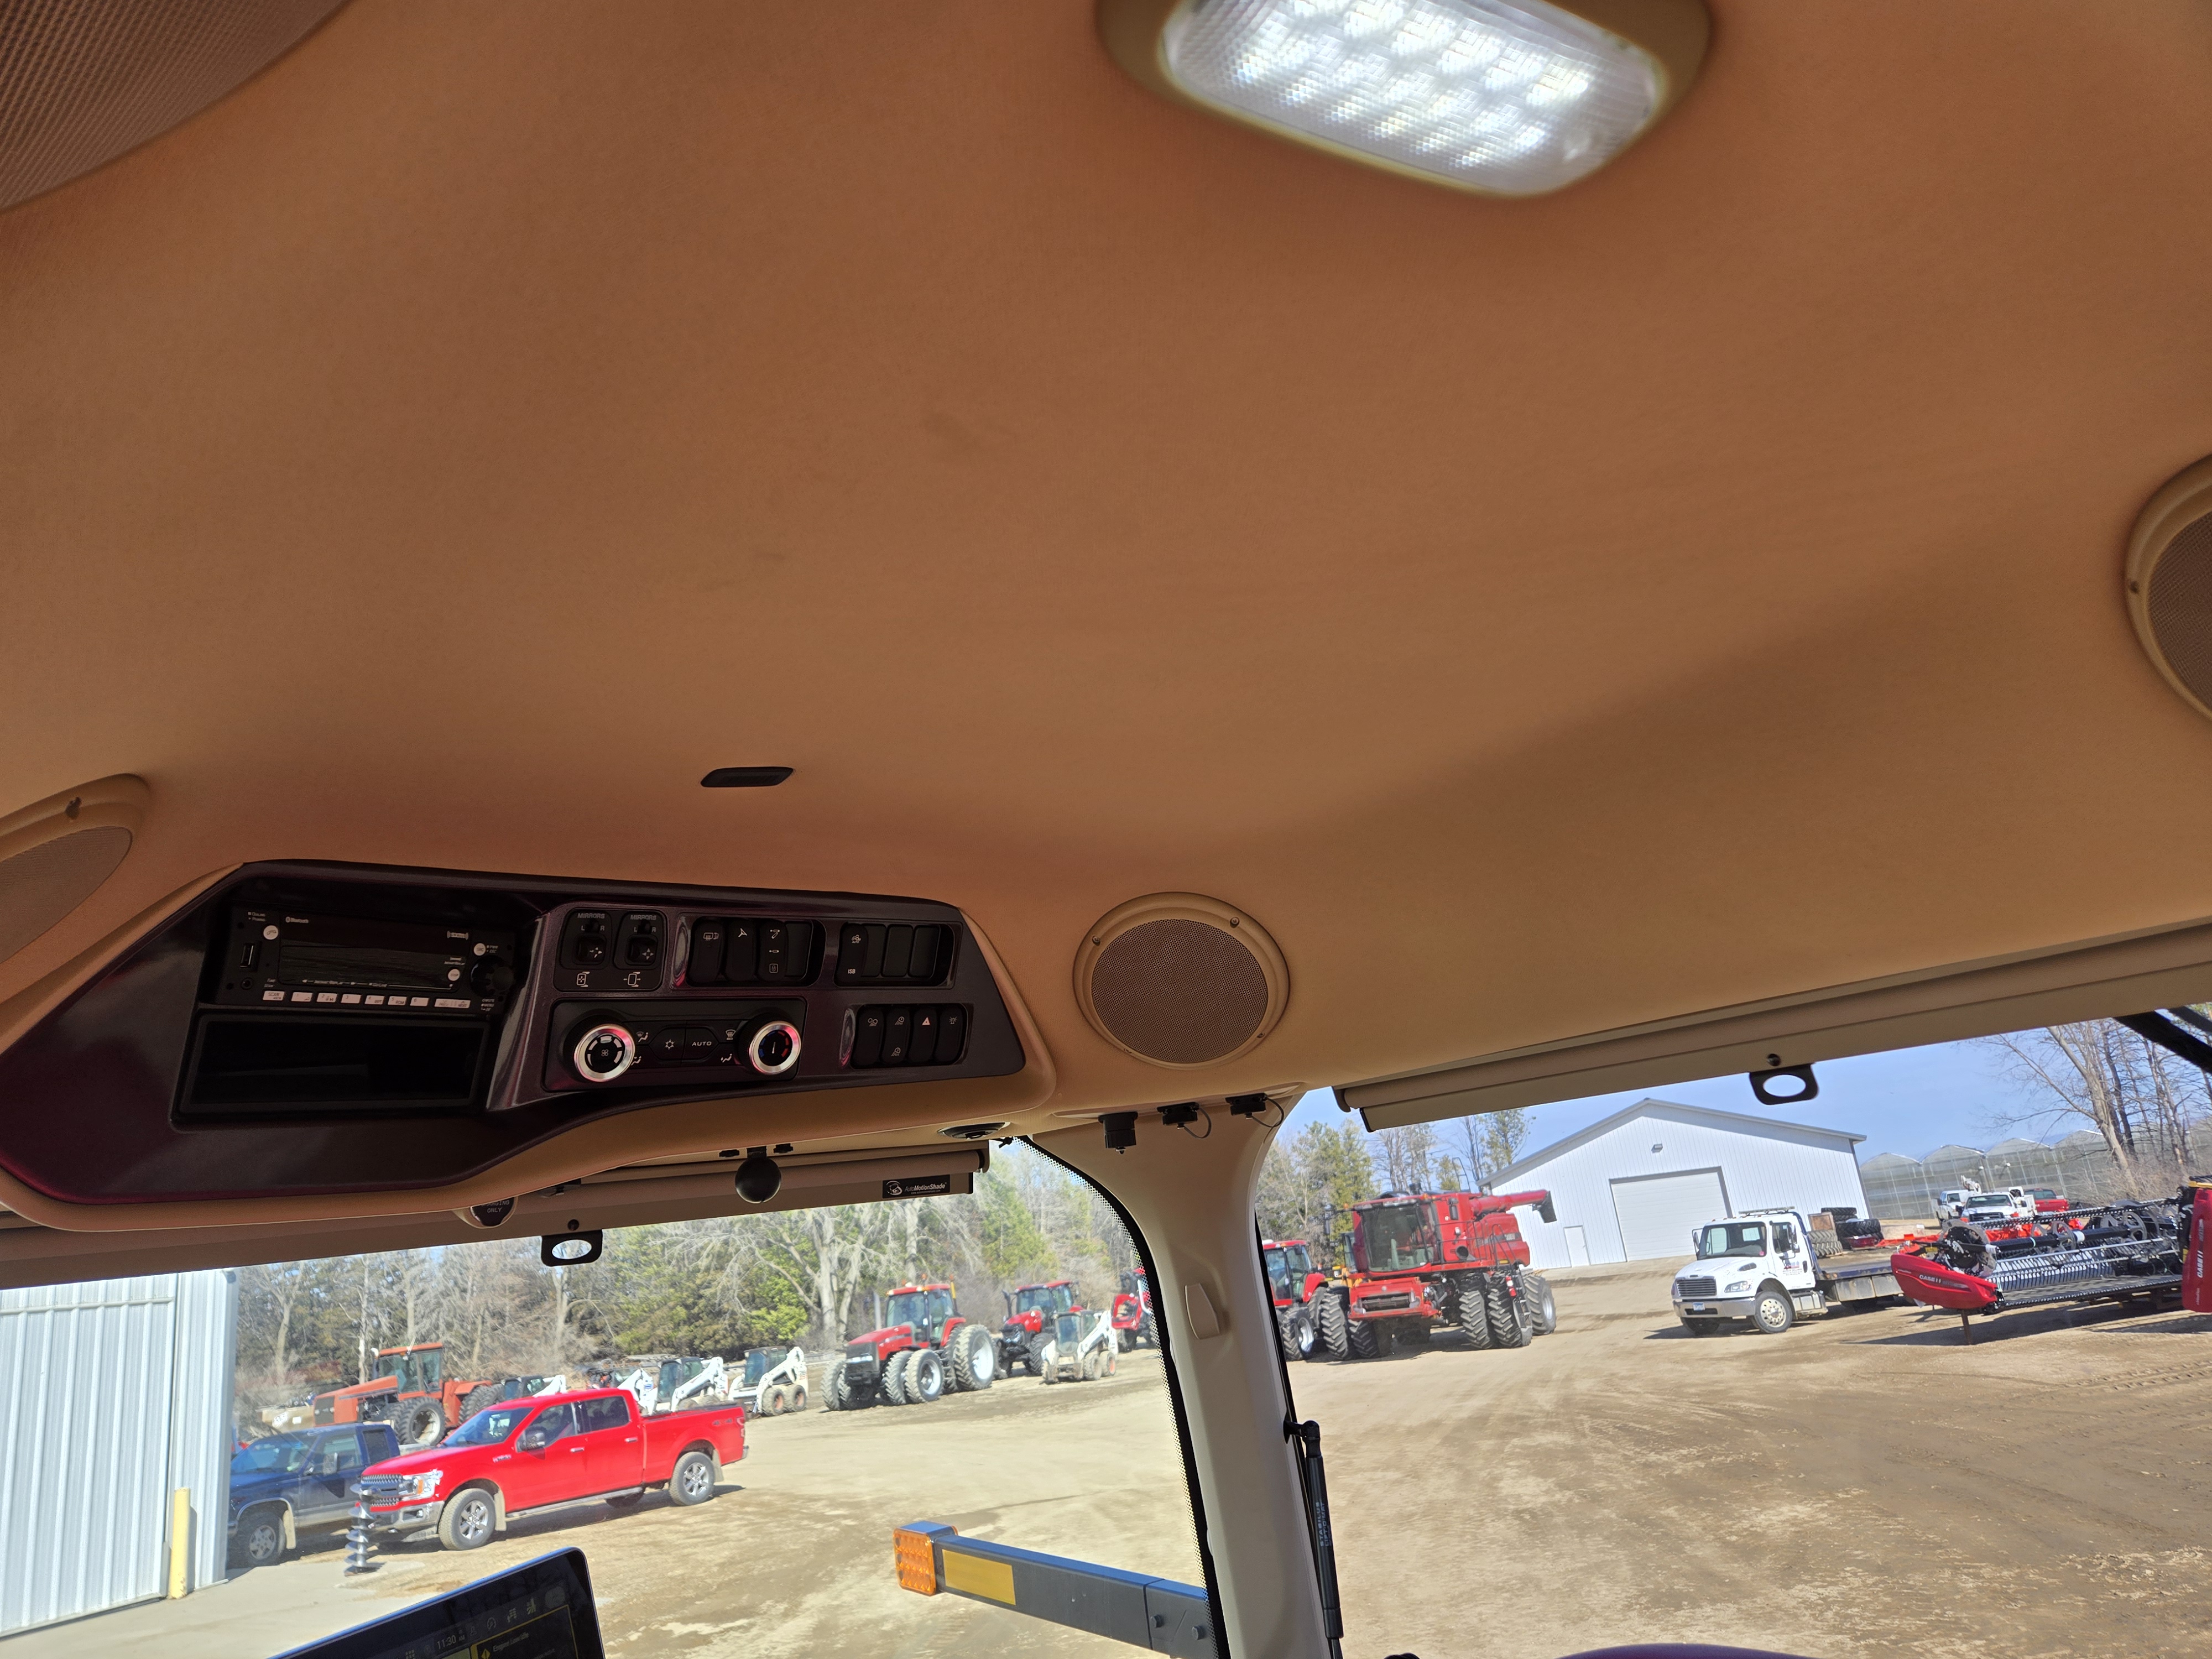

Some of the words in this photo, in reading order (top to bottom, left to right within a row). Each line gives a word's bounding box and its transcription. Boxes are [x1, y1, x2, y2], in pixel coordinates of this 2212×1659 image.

[904, 1182, 946, 1192] AutoMotionShade
[1919, 1274, 1935, 1282] CASE
[436, 1634, 457, 1650] 11:30
